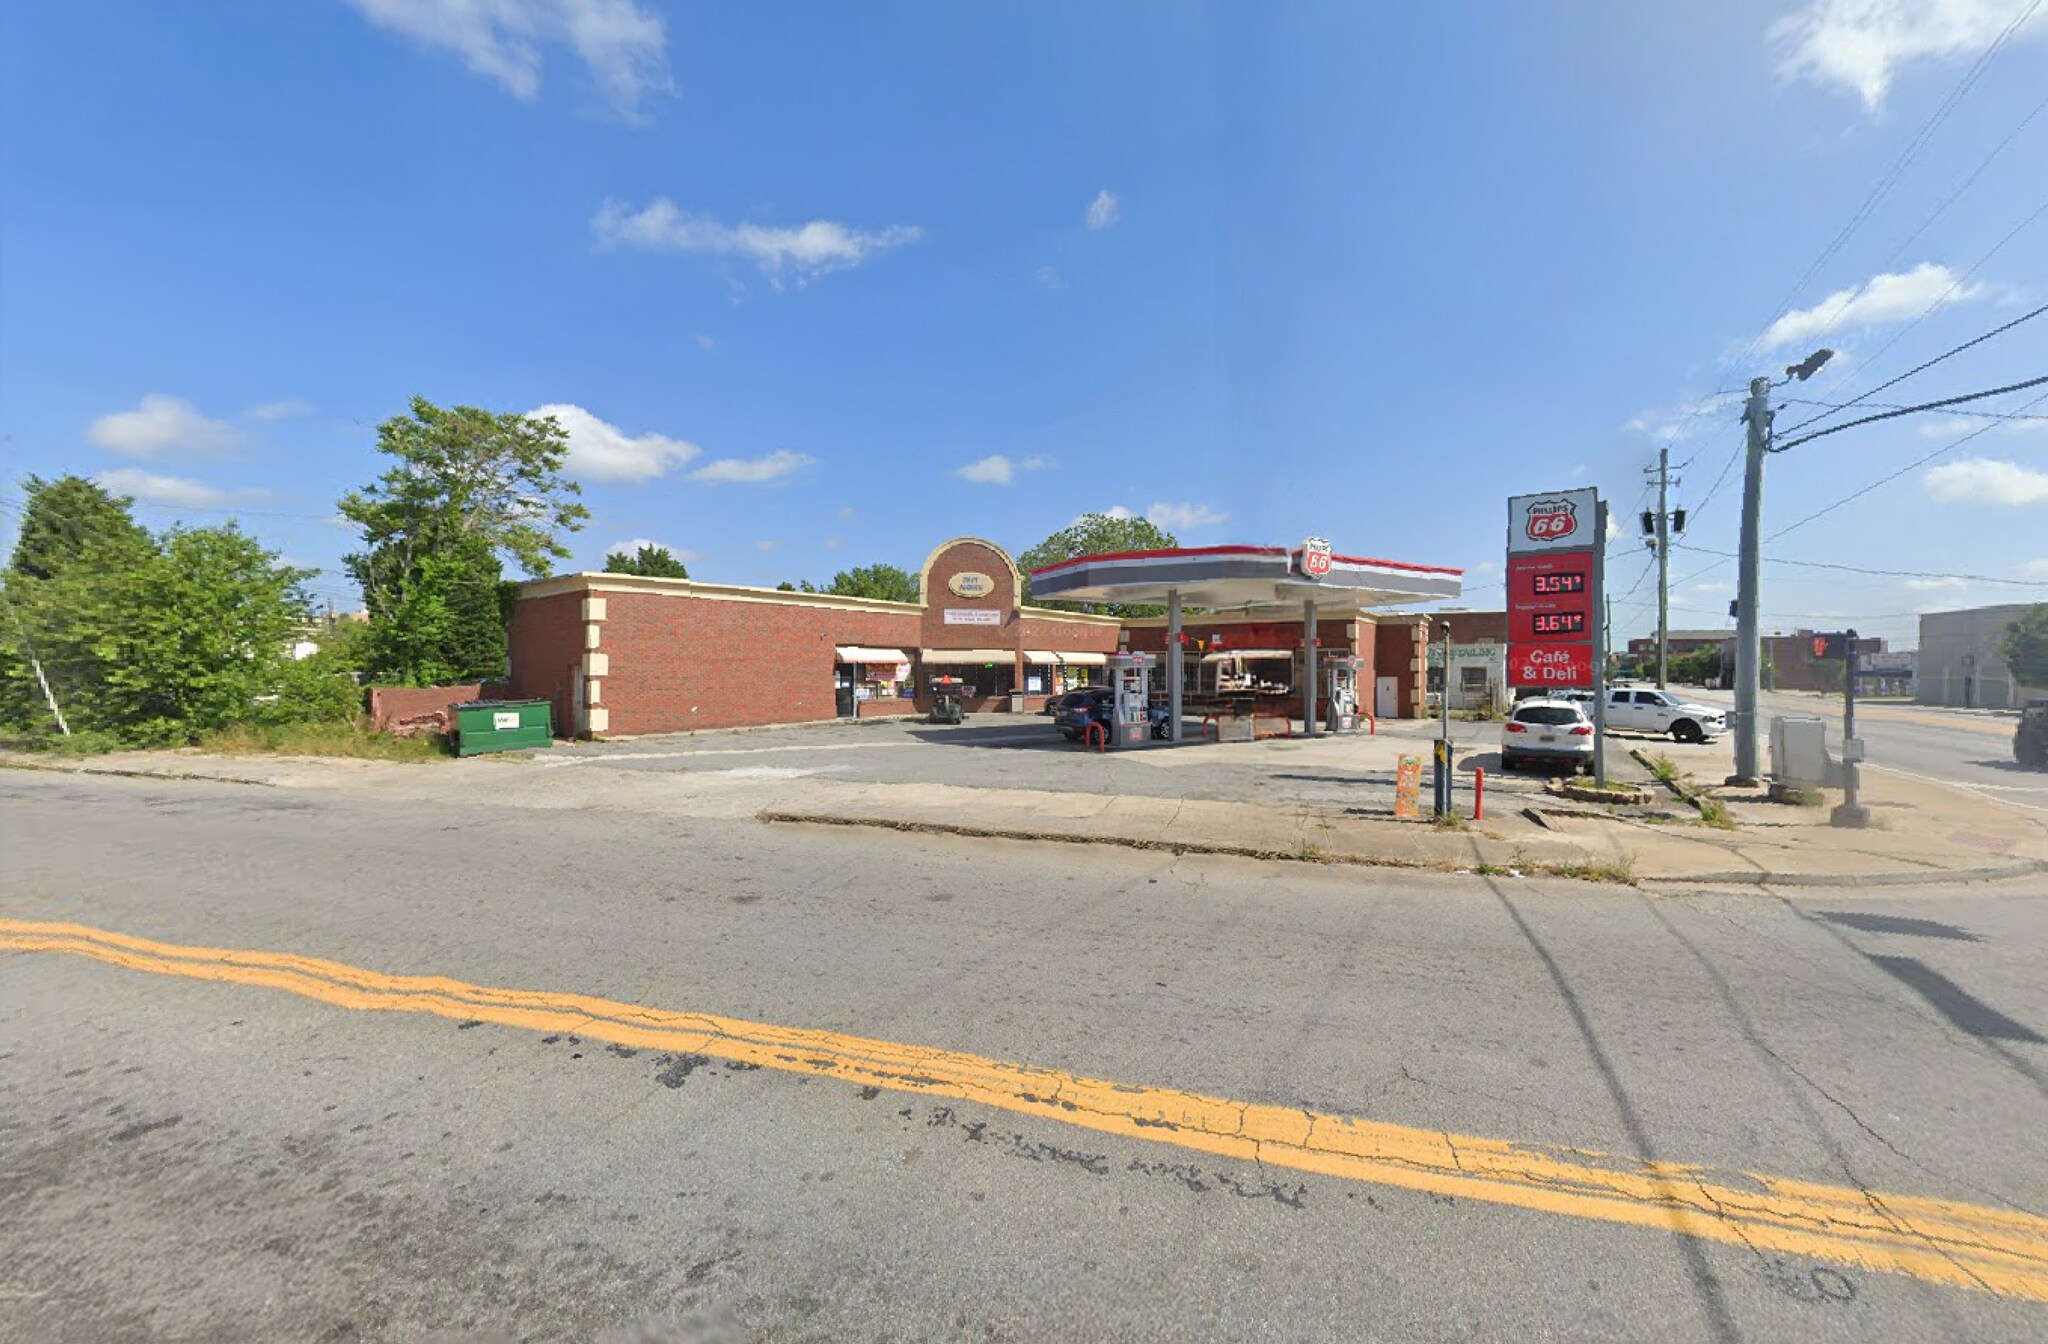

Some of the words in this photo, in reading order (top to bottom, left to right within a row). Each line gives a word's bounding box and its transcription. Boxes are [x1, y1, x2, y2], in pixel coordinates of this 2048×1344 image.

[1534, 516, 1566, 534] 66
[1311, 554, 1328, 569] 66
[1529, 649, 1570, 664] Café
[1522, 665, 1536, 679] &
[1543, 665, 1577, 680] Deli
